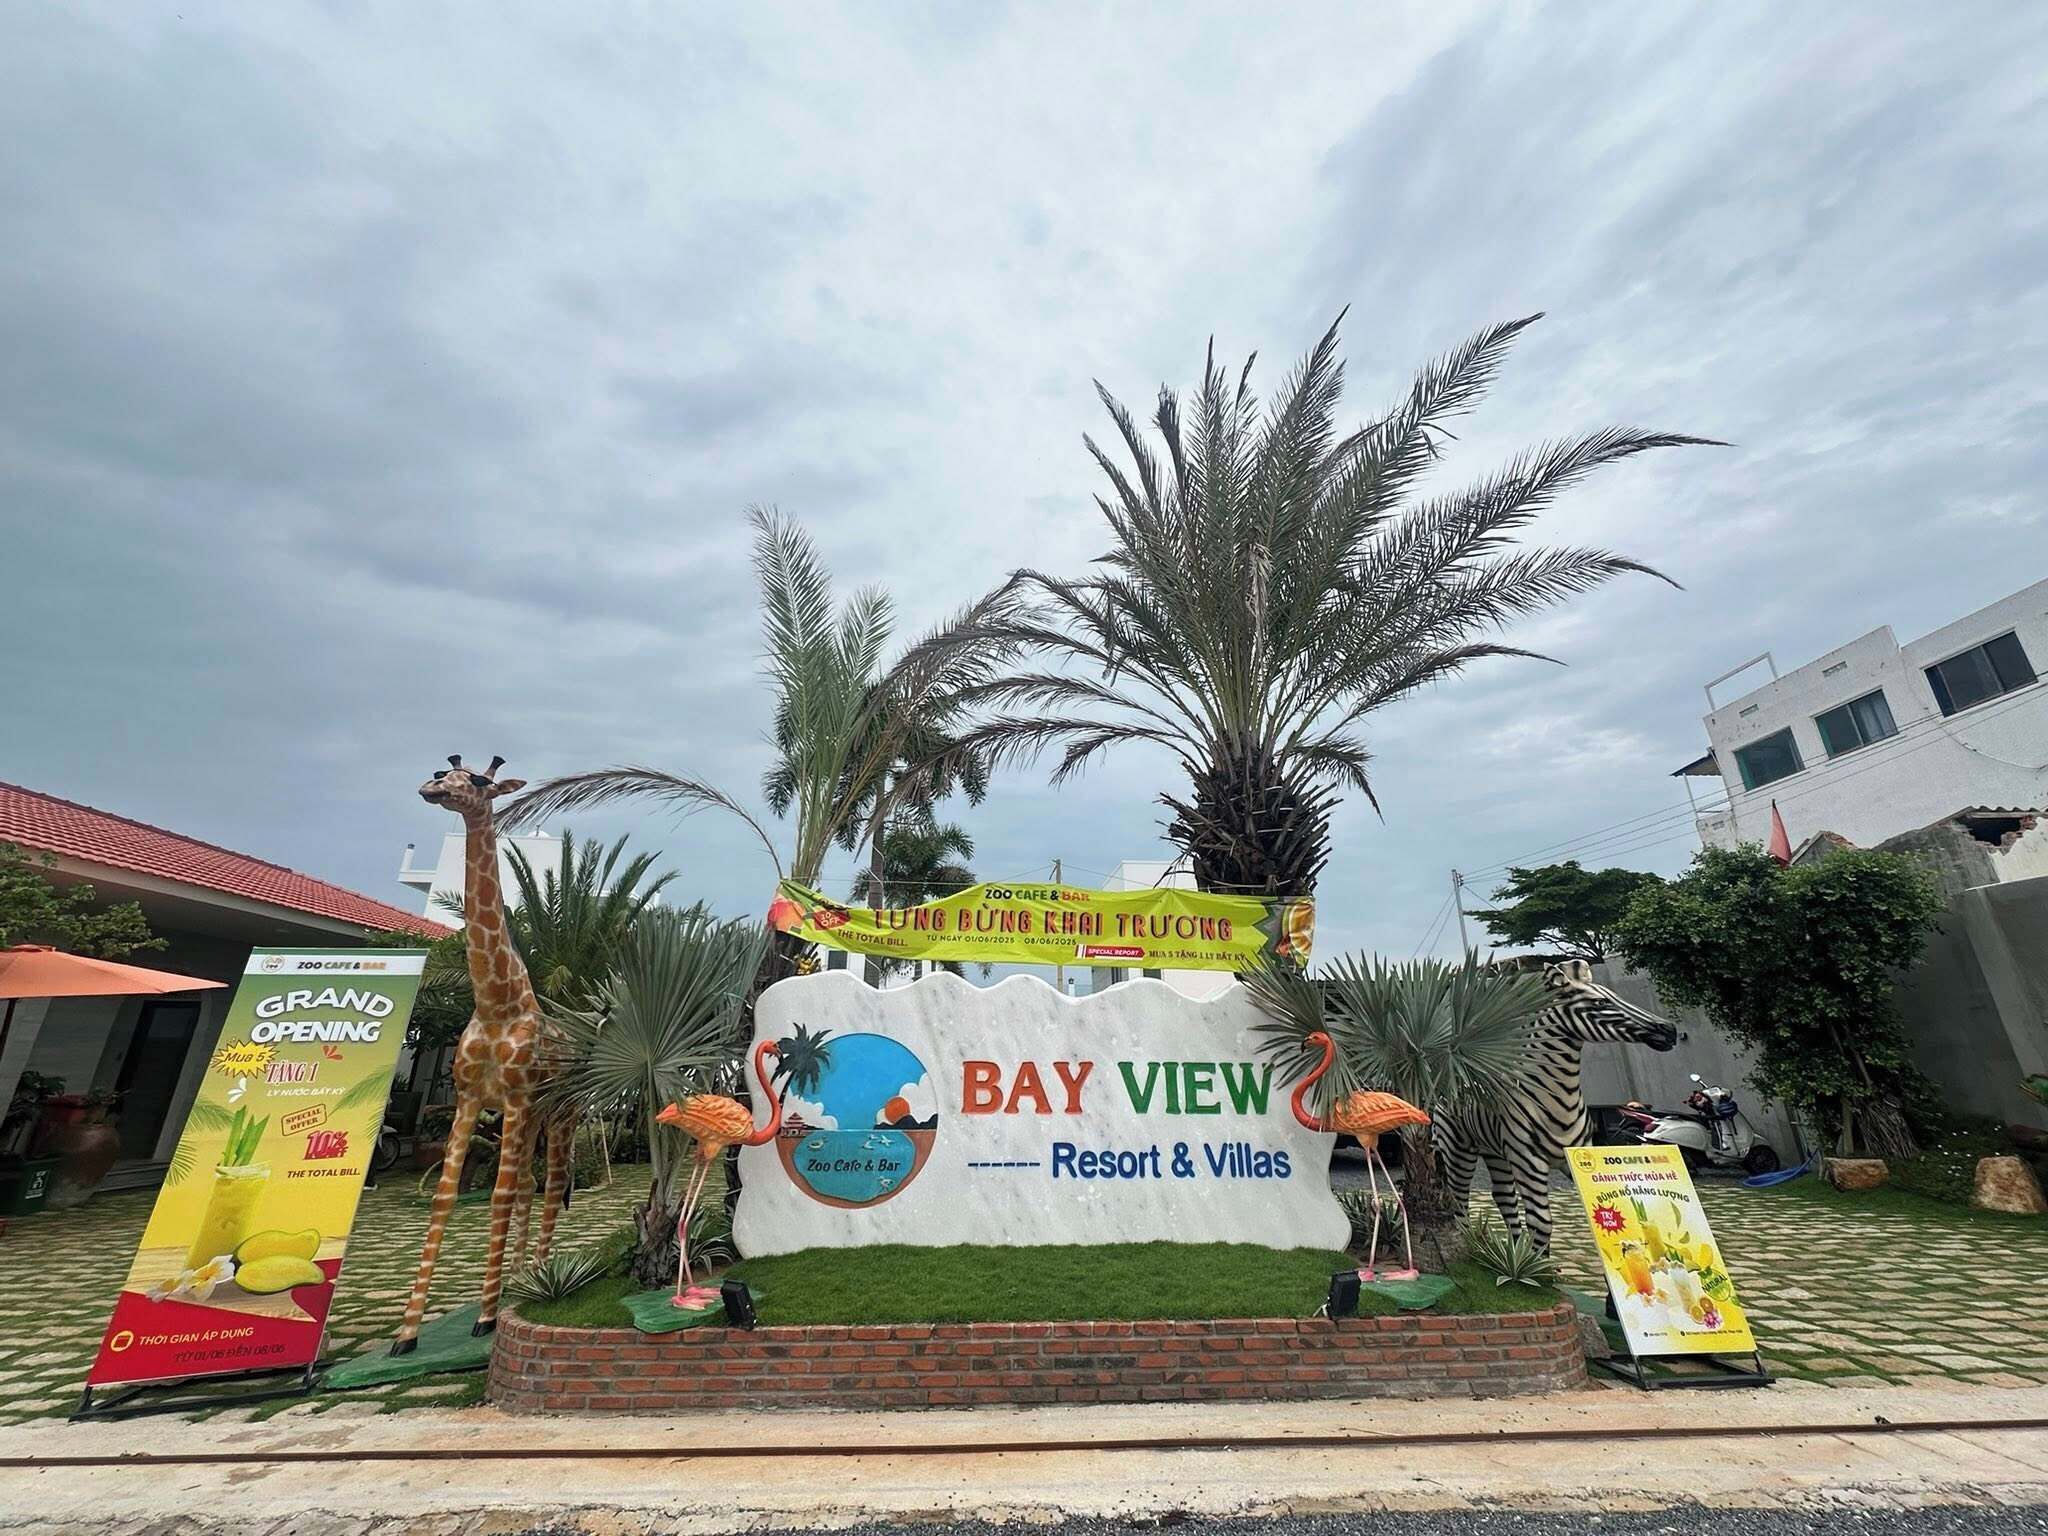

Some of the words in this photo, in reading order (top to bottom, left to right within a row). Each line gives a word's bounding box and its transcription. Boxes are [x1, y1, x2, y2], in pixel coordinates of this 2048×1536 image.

[985, 889, 1013, 900] ZOO
[1015, 889, 1047, 900] CAFE
[1050, 890, 1059, 900] &
[1061, 891, 1090, 901] BAR
[958, 903, 1032, 933] BỪNG
[1044, 911, 1103, 936] KHAI
[1116, 913, 1233, 941] TRƯƠNG
[837, 929, 853, 940] THE
[856, 931, 885, 945] TOTAL
[964, 936, 1015, 944] 01/06/2025
[1024, 937, 1077, 945] 08/06/2025
[1148, 950, 1167, 958] MUA
[1205, 952, 1215, 960] LY
[297, 961, 322, 969] ZOO
[324, 961, 352, 969] CAFE
[255, 987, 394, 1019] GRAND
[250, 1021, 383, 1043] OPENING
[224, 1052, 253, 1062] Mua
[256, 1051, 265, 1062] 5
[309, 1062, 319, 1082] 1
[266, 1089, 280, 1097] LY
[961, 1061, 1093, 1115] BAY
[1118, 1061, 1274, 1115] VIEW
[285, 1108, 321, 1124] SPECIAL
[290, 1117, 318, 1130] OFFER
[807, 1159, 830, 1172] Zoo
[864, 1160, 874, 1172] &
[878, 1159, 900, 1172] Bar
[1052, 1142, 1160, 1178] Resort
[1171, 1142, 1193, 1178] &
[1203, 1142, 1291, 1178] Villas
[1603, 1157, 1622, 1165] ZOO
[1623, 1157, 1643, 1165] CAFE
[287, 1169, 306, 1178] THE
[308, 1169, 337, 1178] TOTAL
[340, 1168, 360, 1176] BILL.
[1645, 1171, 1665, 1181] MÙA
[1600, 1211, 1613, 1220] TRY
[1603, 1219, 1618, 1227] NOW
[1702, 1273, 1728, 1294] NATURAL
[169, 1333, 199, 1344] GIAN
[201, 1329, 218, 1342] ÁP
[220, 1327, 254, 1340] DỤNG
